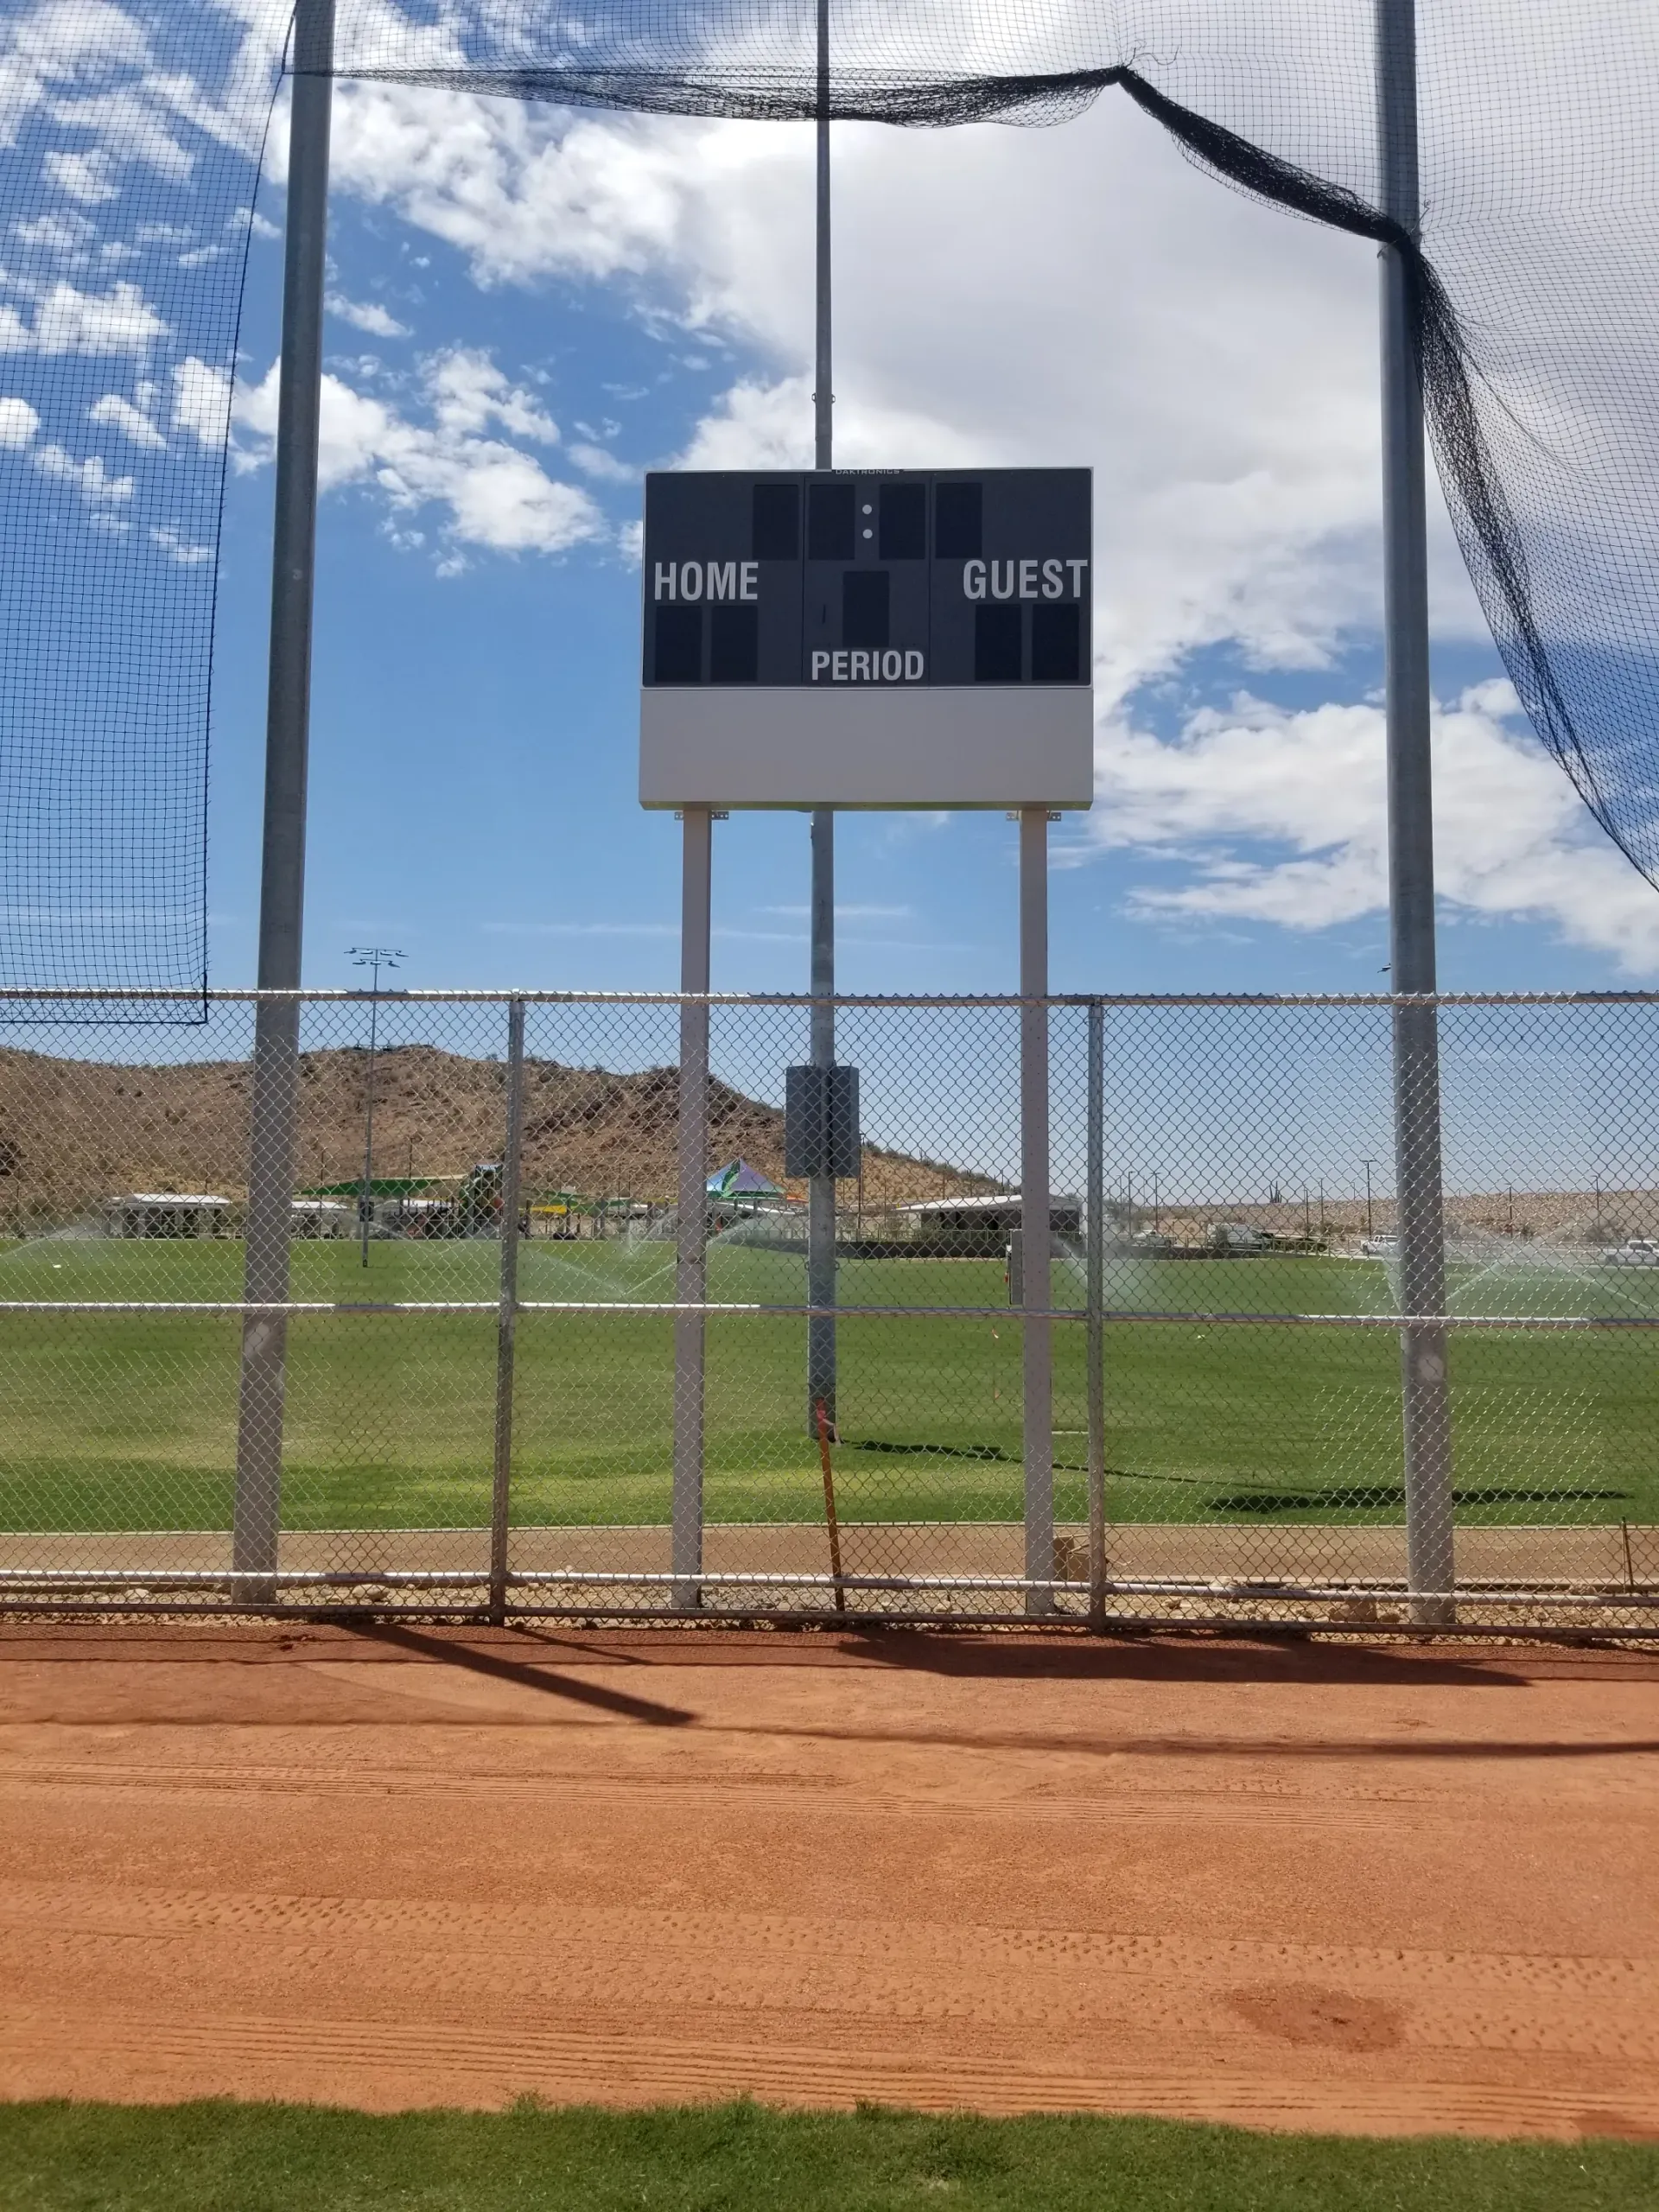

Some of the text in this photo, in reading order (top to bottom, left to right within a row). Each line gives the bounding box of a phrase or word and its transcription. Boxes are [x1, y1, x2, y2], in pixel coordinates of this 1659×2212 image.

[654, 562, 759, 601] HOME
[963, 559, 1088, 600] GUEST
[810, 650, 925, 681] PERIOD
